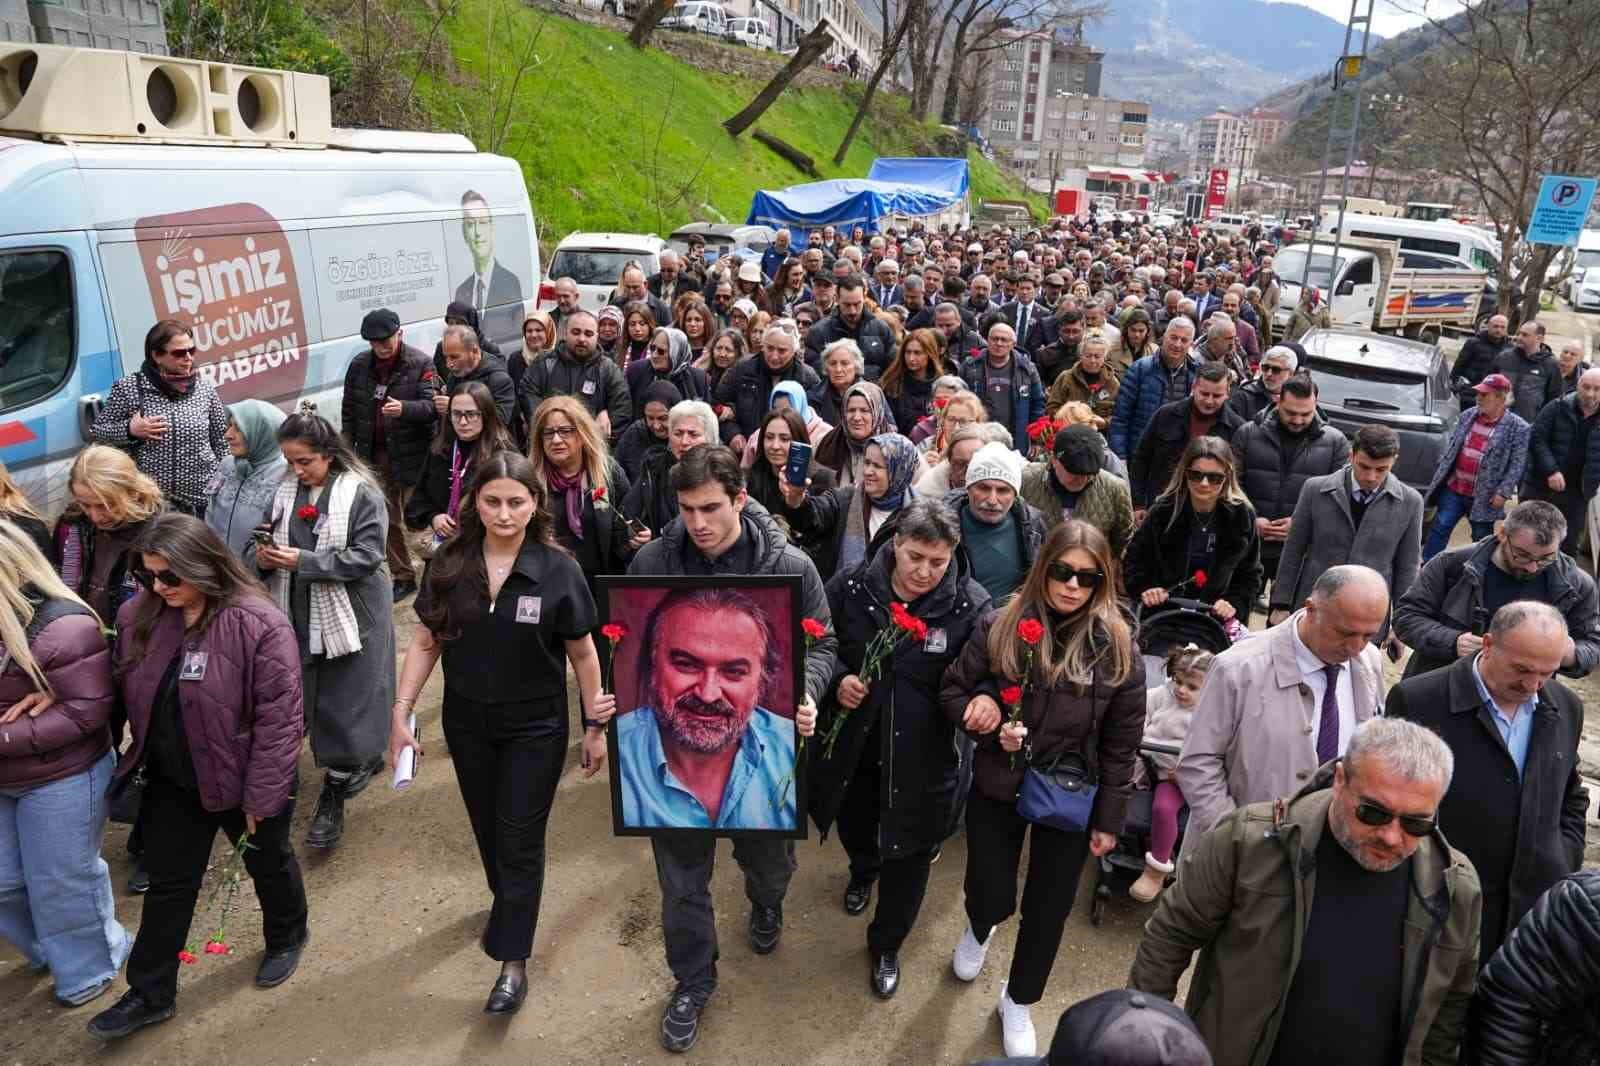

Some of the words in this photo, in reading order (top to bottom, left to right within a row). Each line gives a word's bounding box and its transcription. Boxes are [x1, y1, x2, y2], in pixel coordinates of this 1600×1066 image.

[156, 237, 286, 314] işimiz
[328, 253, 393, 285] ÖZGÜR
[396, 249, 440, 275] ÖZEL
[191, 296, 294, 352] ÜCÜMÜZ
[197, 332, 300, 388] RABZON
